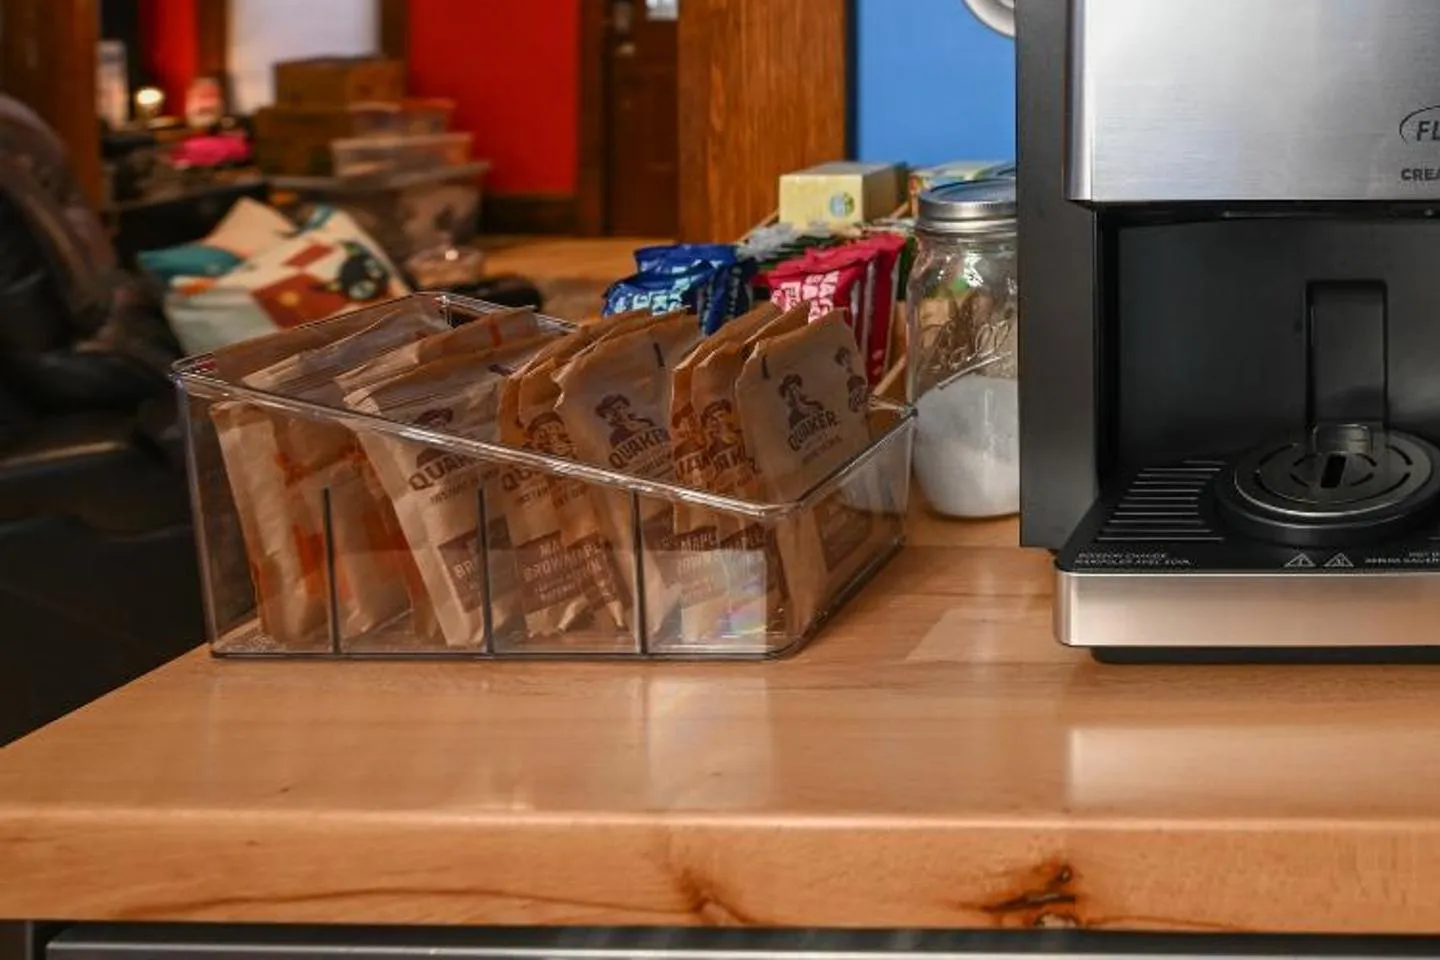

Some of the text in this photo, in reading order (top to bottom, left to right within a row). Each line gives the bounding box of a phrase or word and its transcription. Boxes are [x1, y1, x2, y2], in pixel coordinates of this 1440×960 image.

[608, 427, 664, 469] QUAKE
[788, 411, 839, 452] QUAKER
[408, 451, 476, 491] QUAK
